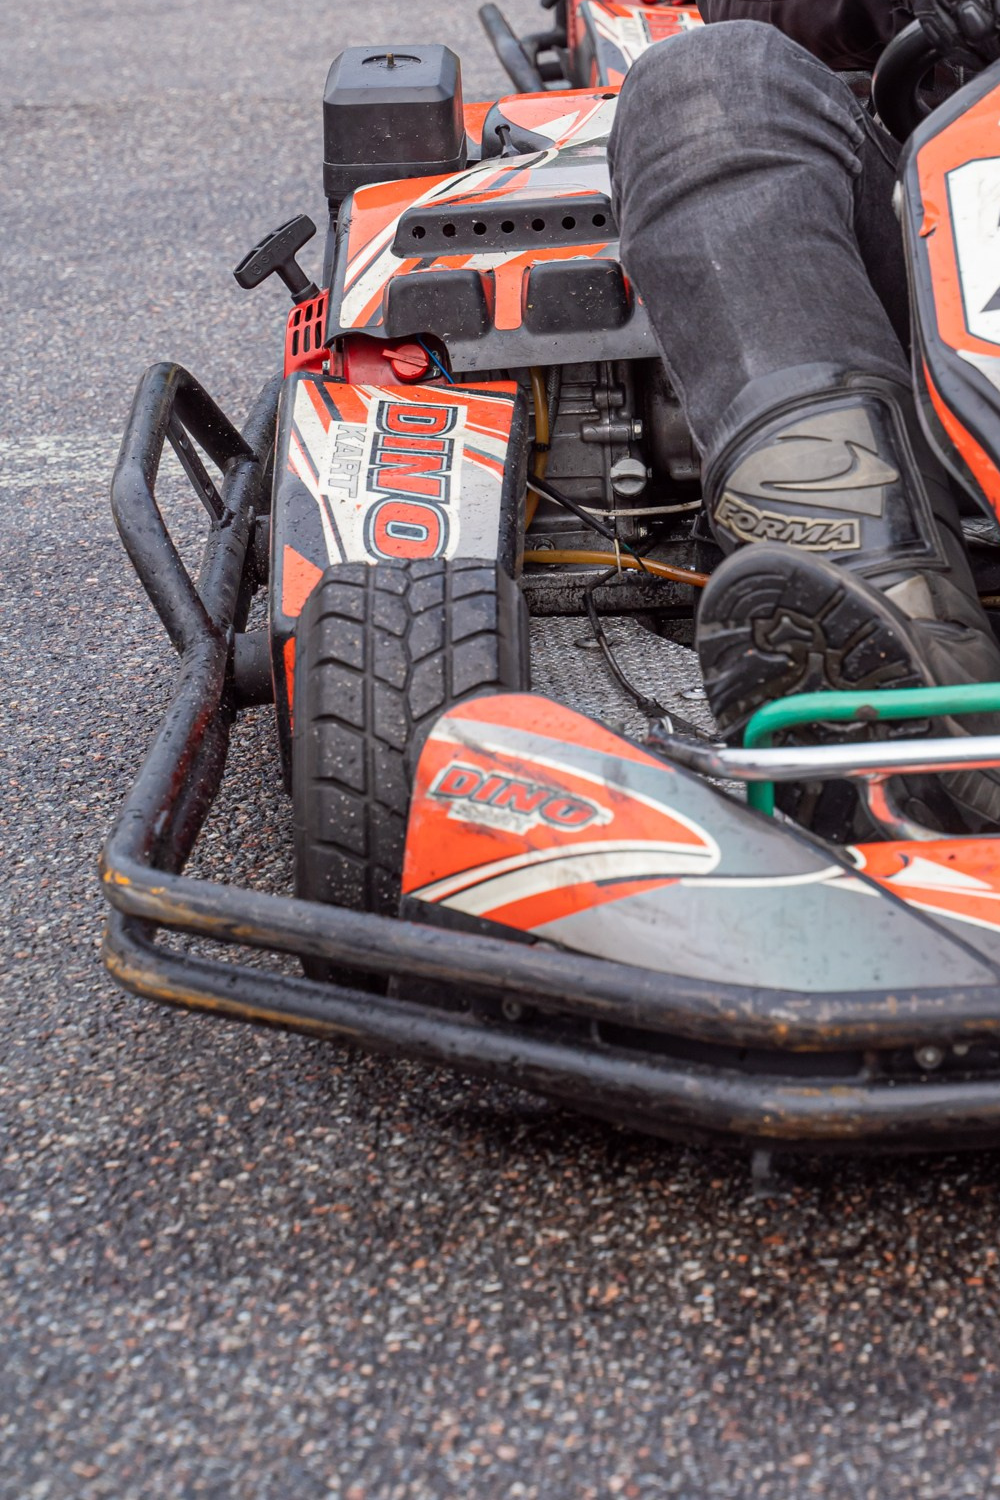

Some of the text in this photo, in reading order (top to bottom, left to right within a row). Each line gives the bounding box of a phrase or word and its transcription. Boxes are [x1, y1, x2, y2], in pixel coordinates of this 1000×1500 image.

[328, 423, 367, 498] KART
[367, 400, 459, 560] DINO
[719, 502, 857, 546] FORMA
[430, 764, 599, 827] DINO
